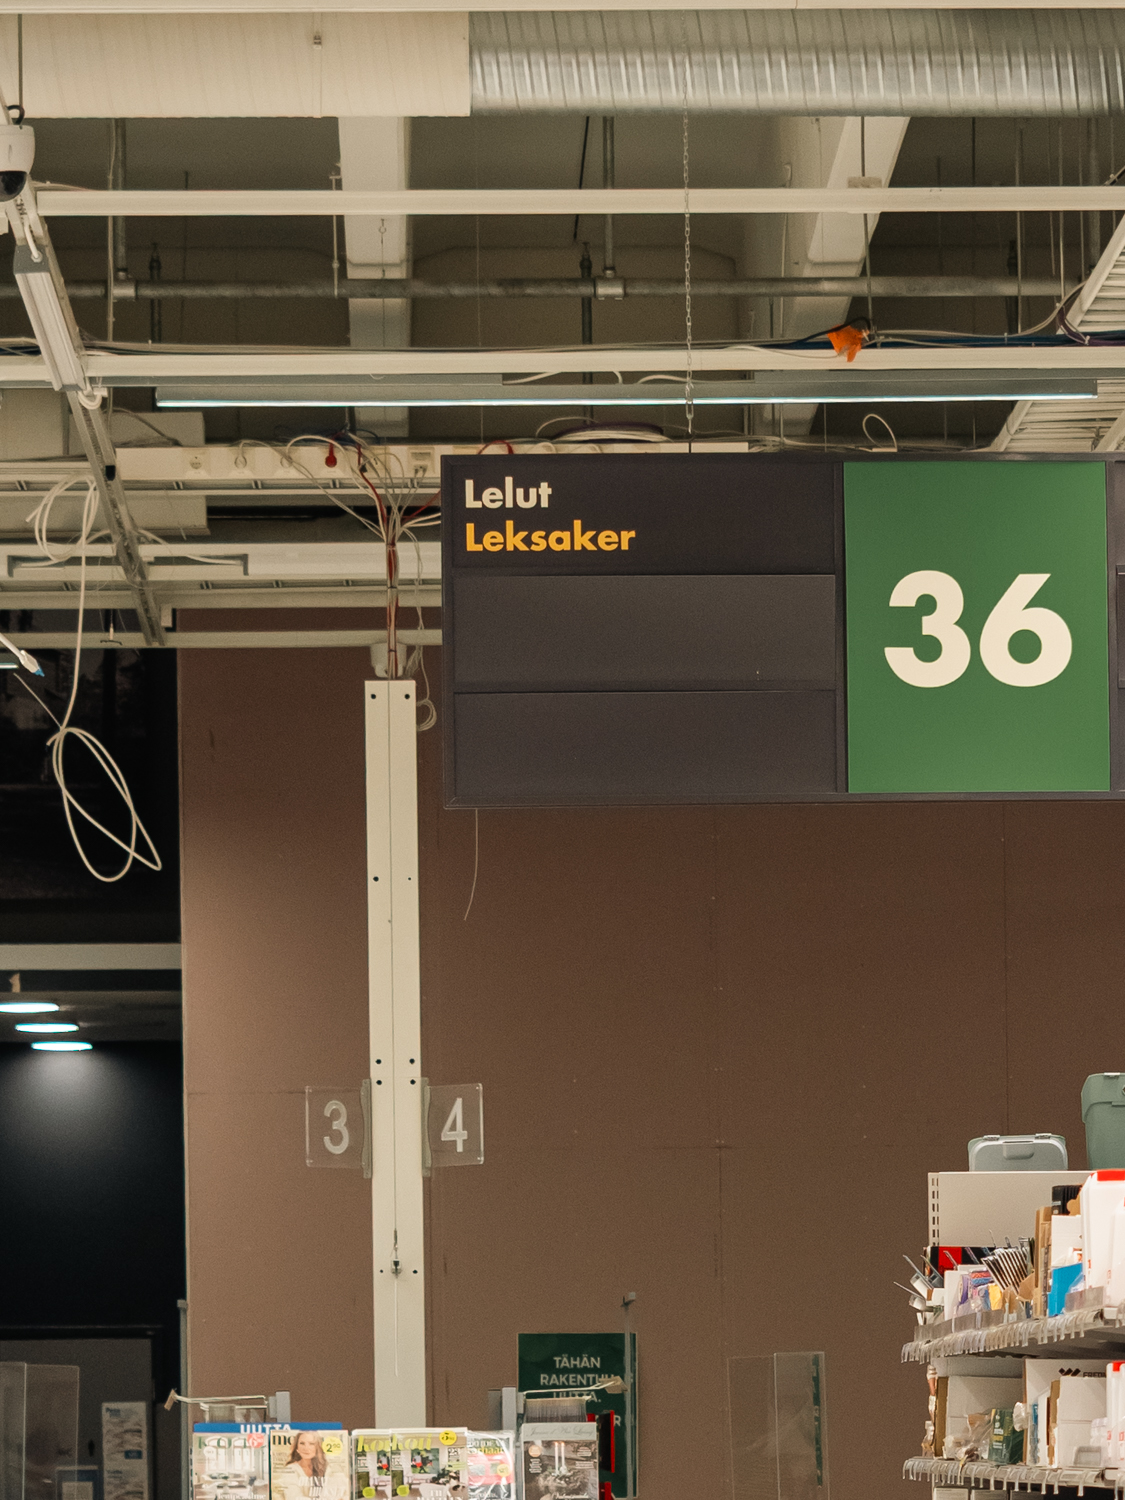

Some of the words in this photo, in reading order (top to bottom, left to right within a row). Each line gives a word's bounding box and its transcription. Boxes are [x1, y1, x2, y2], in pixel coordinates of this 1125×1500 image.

[465, 476, 552, 509] Lelut
[465, 519, 636, 552] Leksaker
[884, 570, 1073, 688] 36
[323, 1100, 350, 1155] 3
[441, 1097, 468, 1153] 4
[553, 1353, 601, 1369] TÄHÄN
